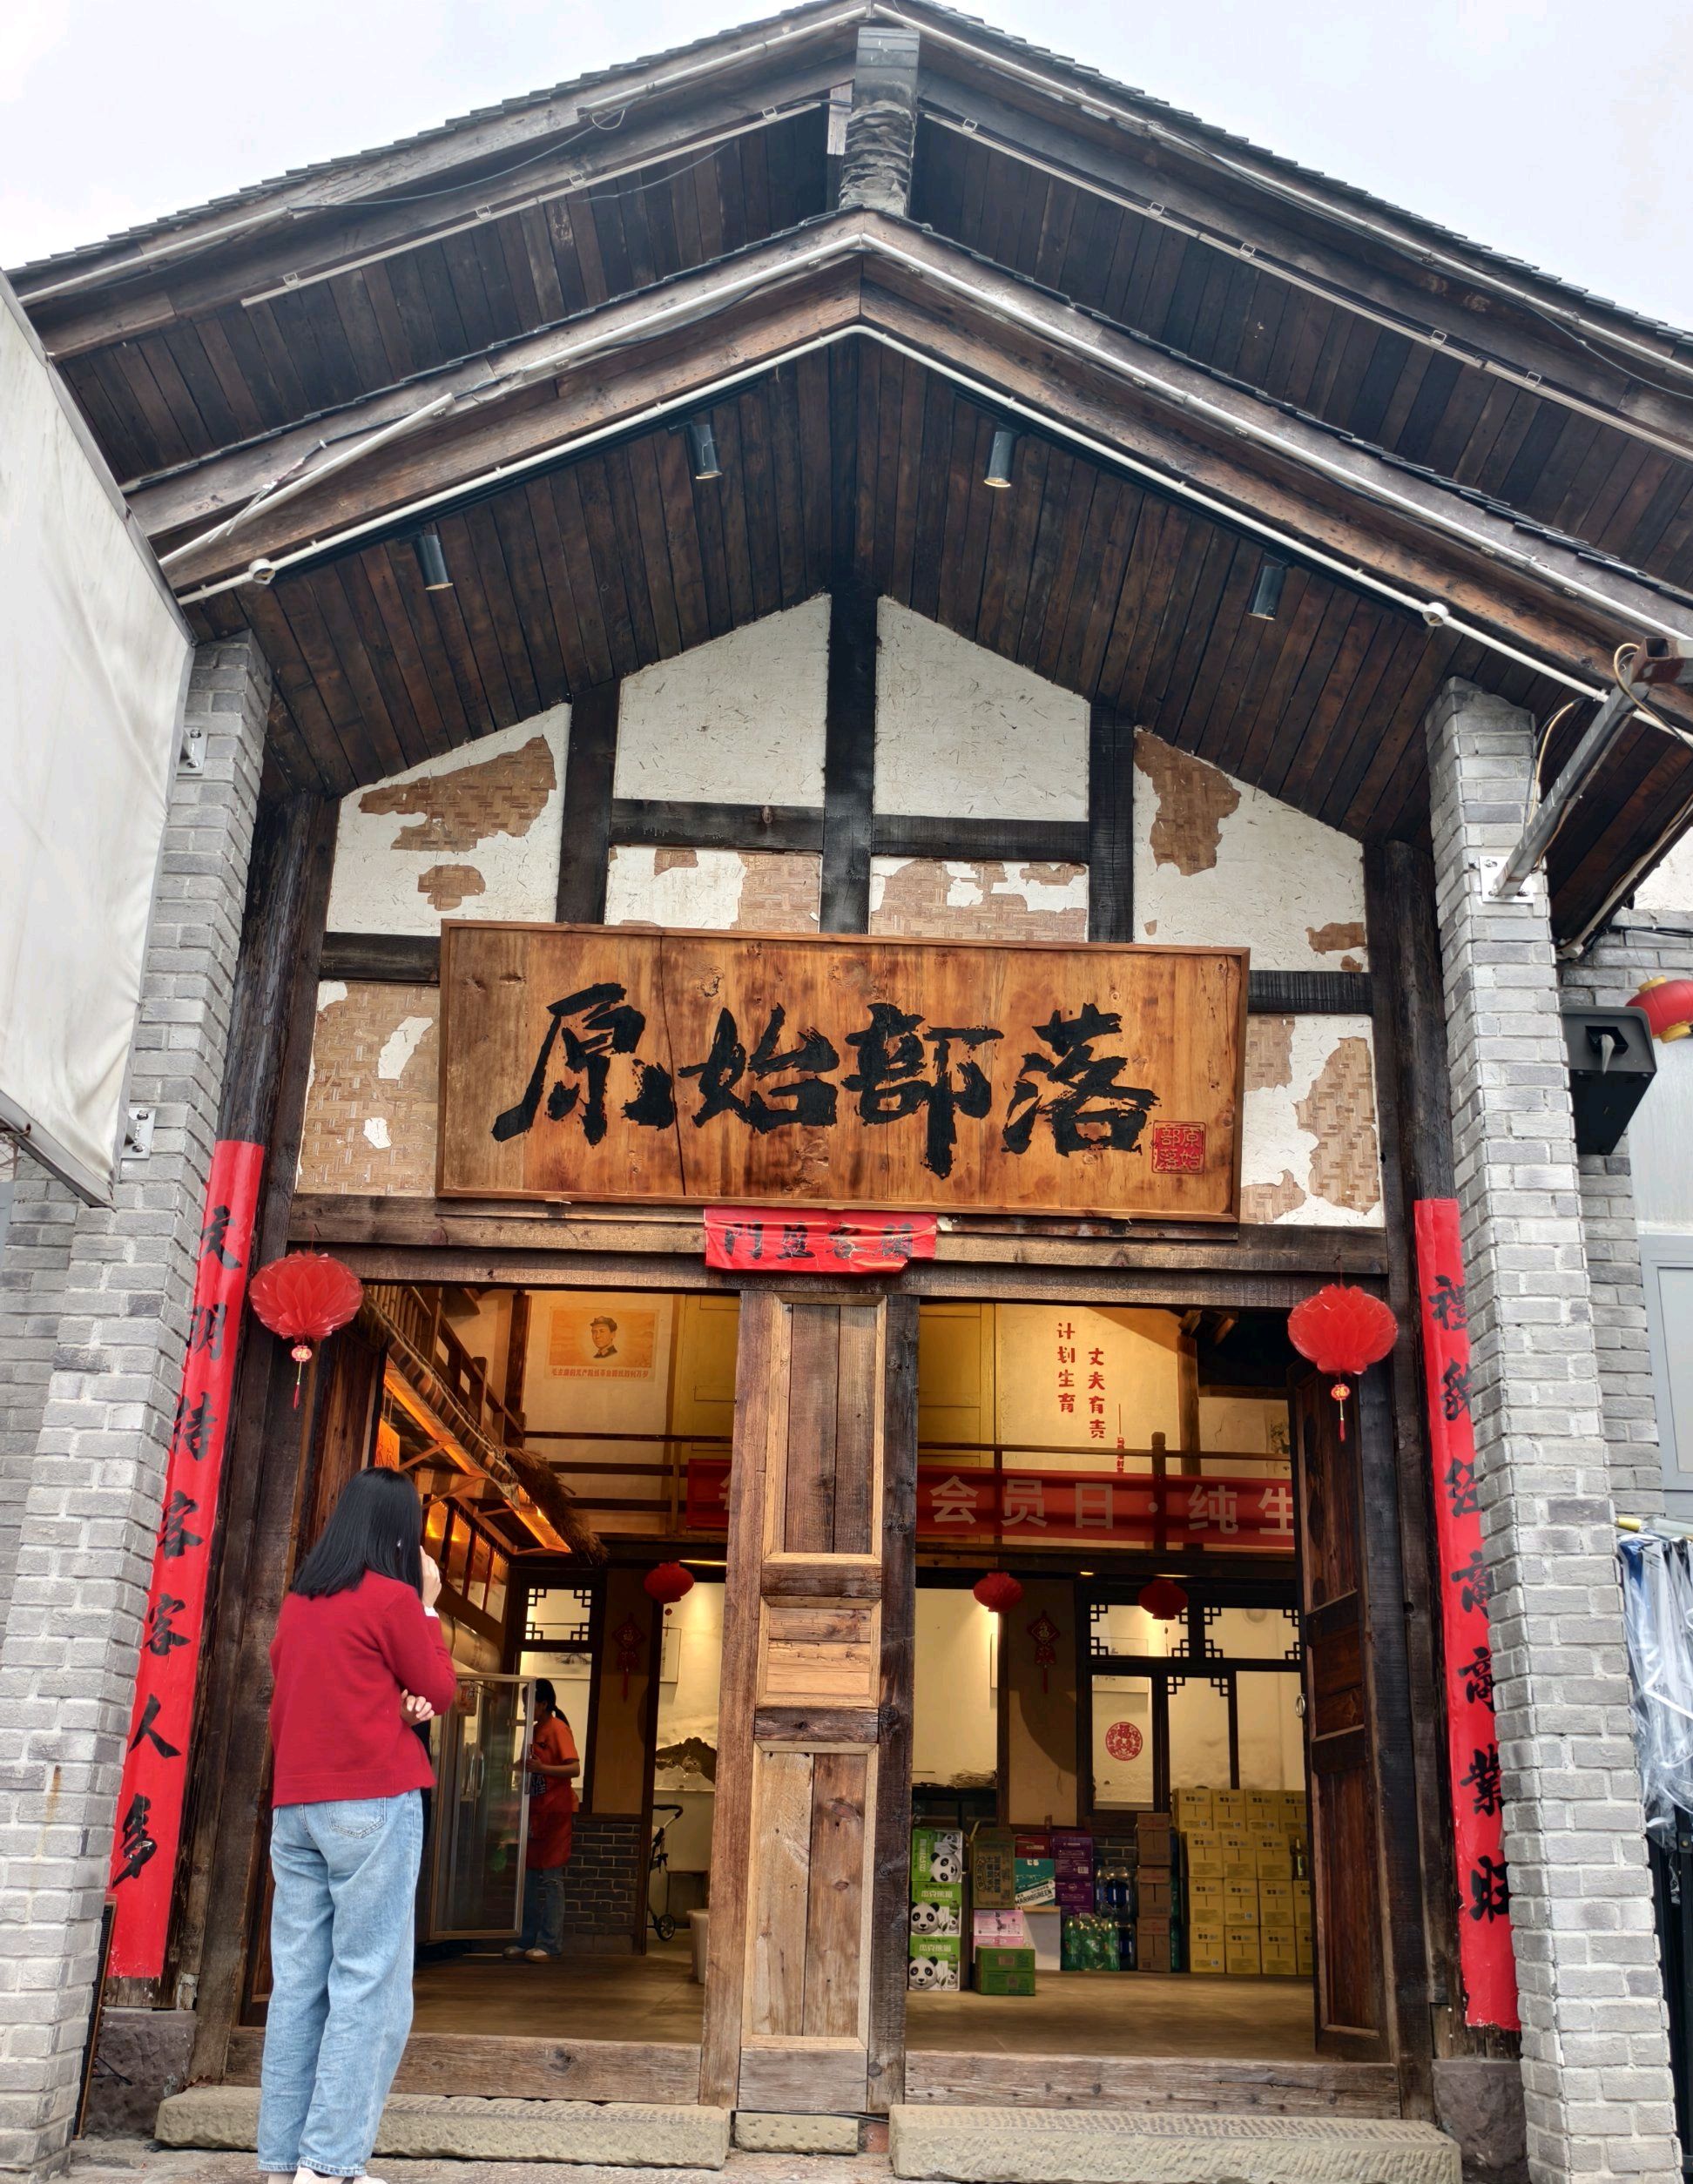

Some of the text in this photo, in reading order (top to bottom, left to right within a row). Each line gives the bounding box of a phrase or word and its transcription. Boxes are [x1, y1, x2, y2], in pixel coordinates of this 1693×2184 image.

[491, 982, 1160, 1179] 原始部落
[1056, 1322, 1076, 1414] 计划生育
[1088, 1347, 1106, 1439] 丈夫有责
